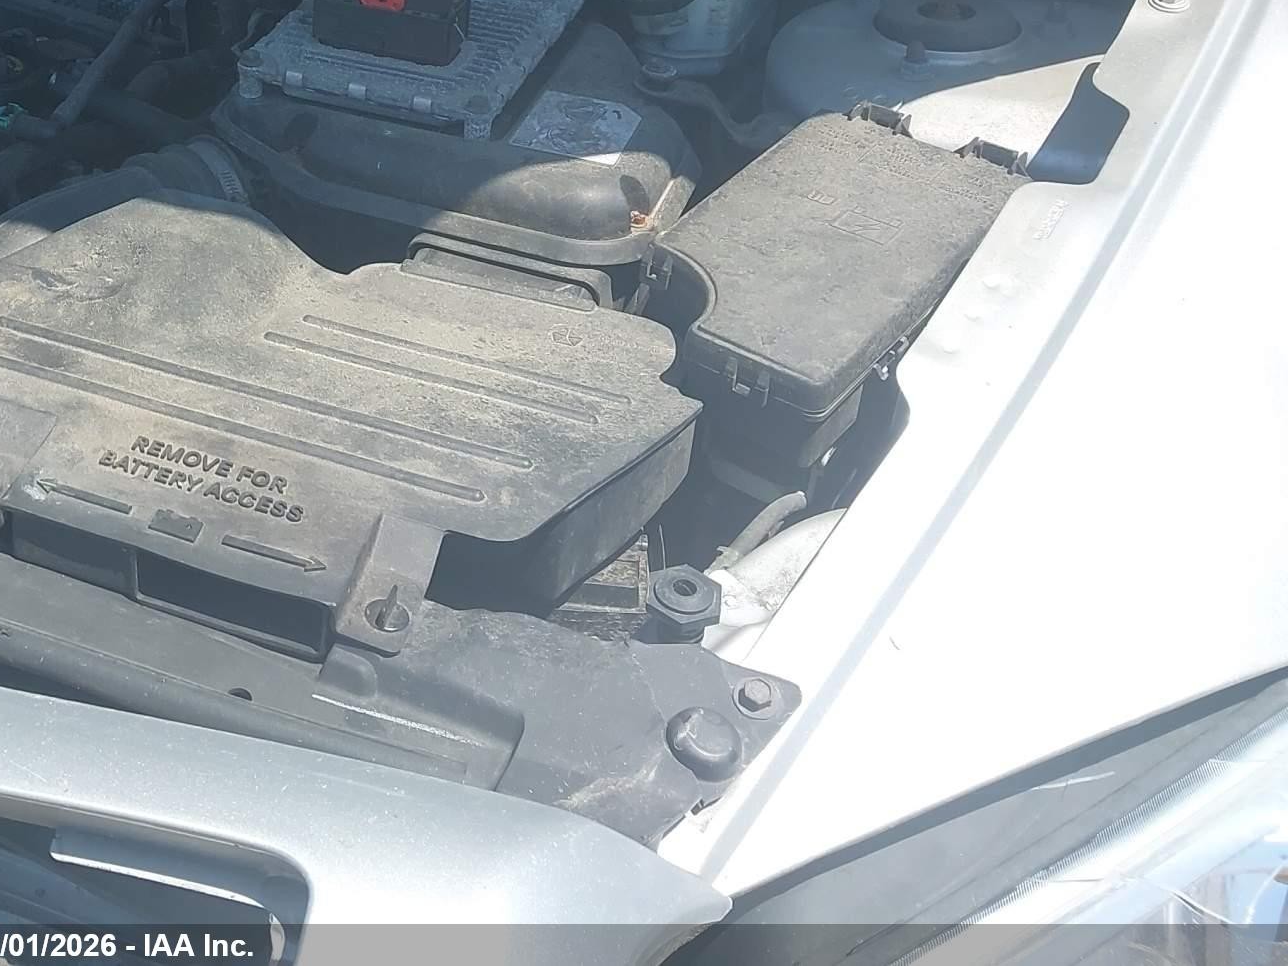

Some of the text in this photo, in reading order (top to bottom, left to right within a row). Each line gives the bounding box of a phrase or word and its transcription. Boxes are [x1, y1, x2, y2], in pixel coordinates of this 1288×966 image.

[99, 450, 304, 522] BATTERY ACCESS
[131, 435, 288, 494] REMOVE FOR
